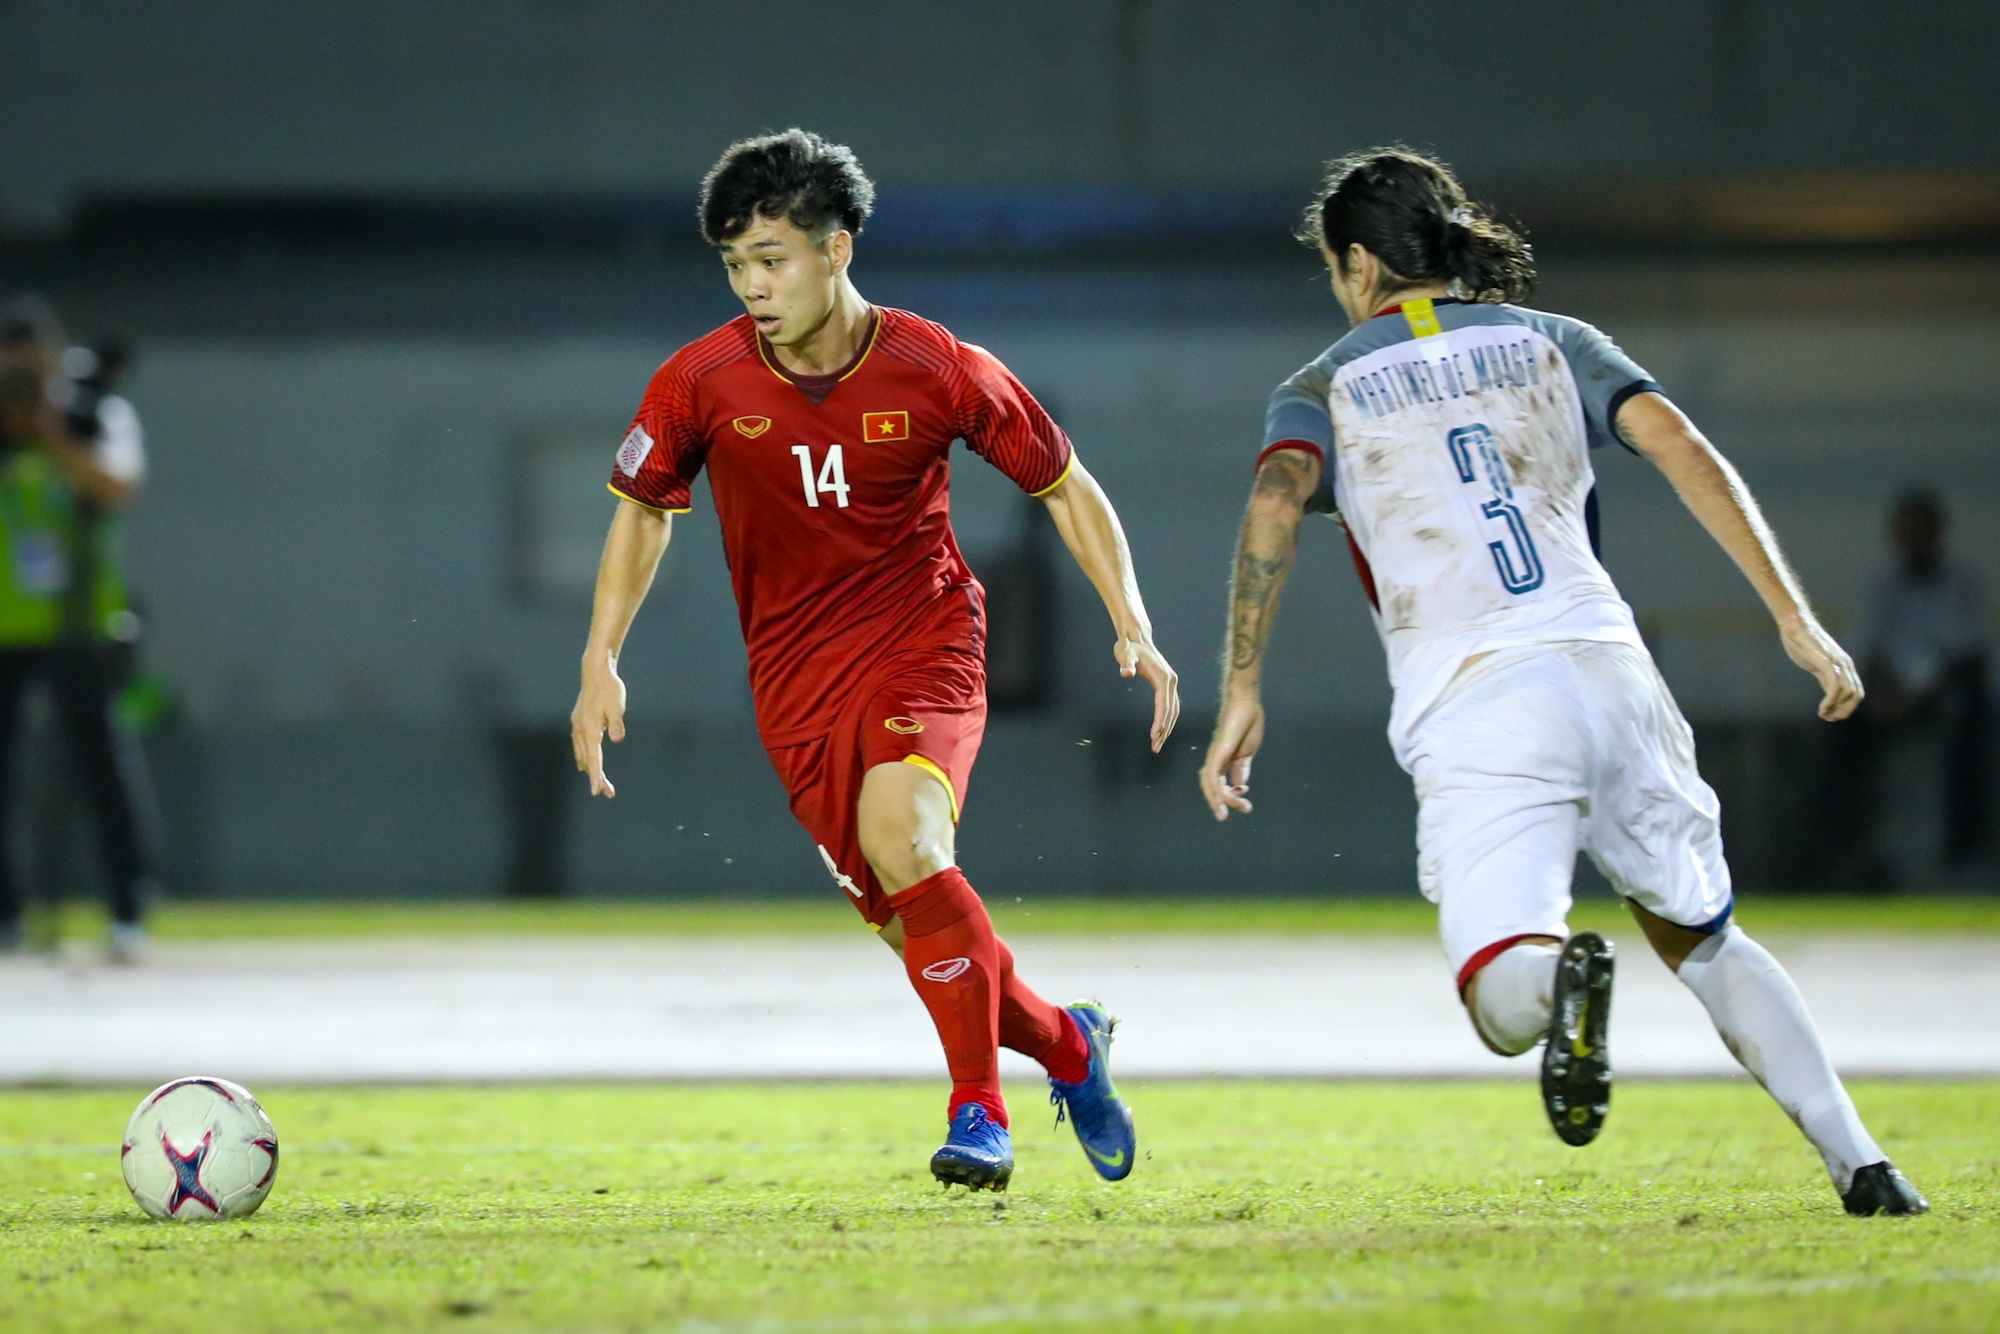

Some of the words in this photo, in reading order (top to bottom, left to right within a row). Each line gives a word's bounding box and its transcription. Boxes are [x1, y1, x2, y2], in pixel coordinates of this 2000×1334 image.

[1440, 353, 1472, 399] DE
[790, 444, 851, 508] 14
[1447, 422, 1545, 596] 3
